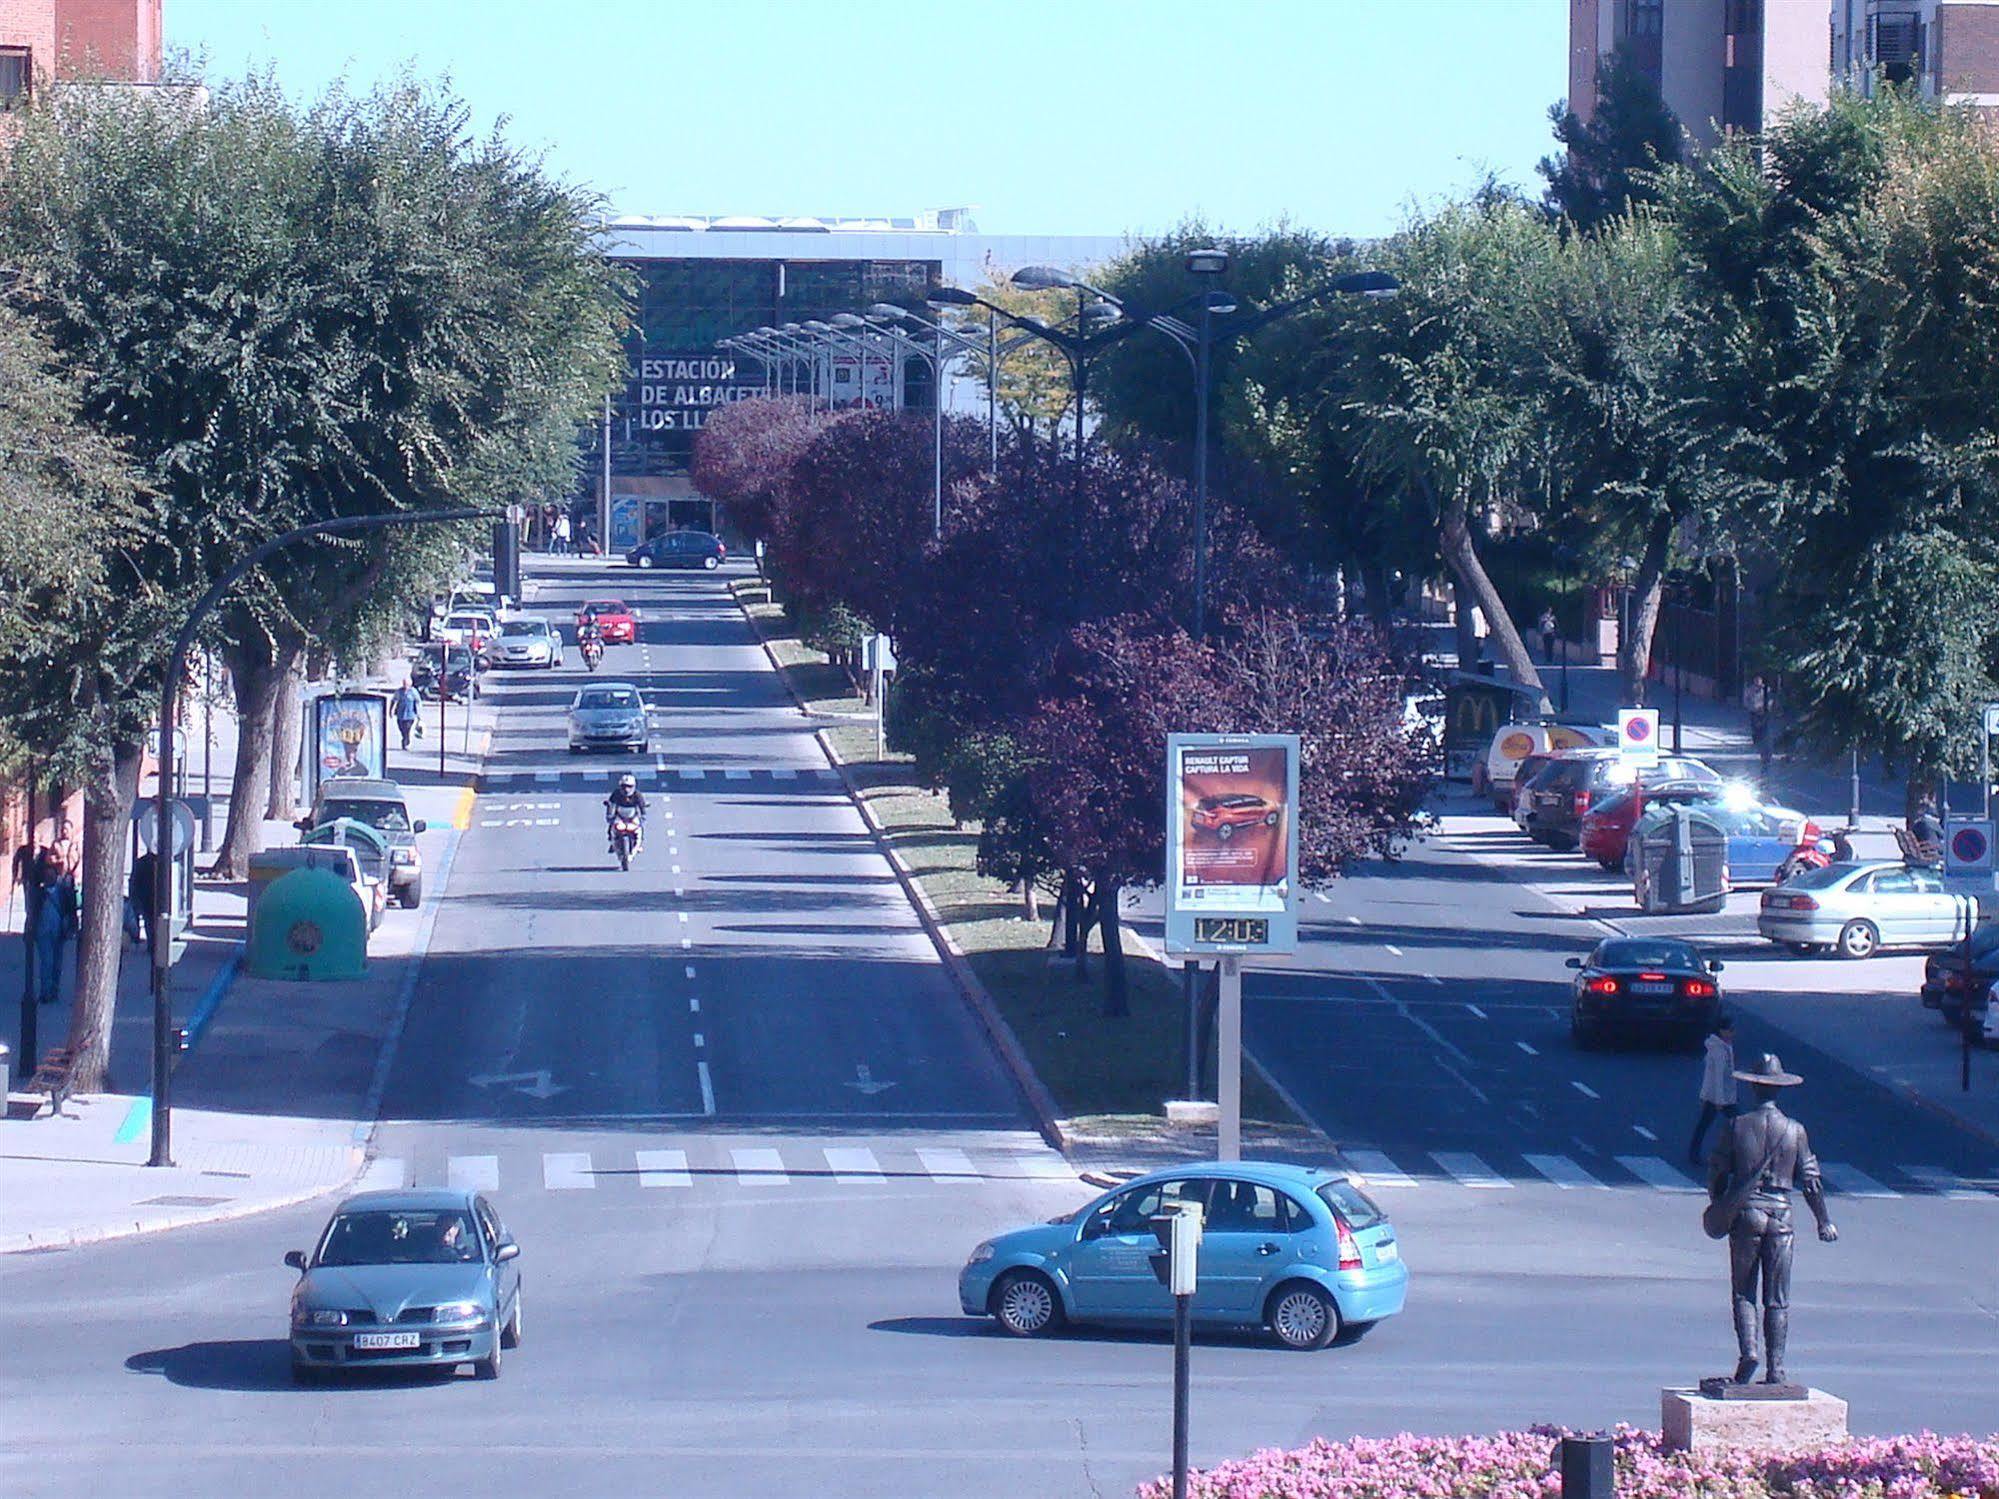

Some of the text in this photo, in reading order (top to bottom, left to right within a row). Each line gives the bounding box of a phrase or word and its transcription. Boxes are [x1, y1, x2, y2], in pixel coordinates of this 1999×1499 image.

[641, 355, 736, 380] ESTACIÓN
[641, 386, 668, 405] DE
[641, 410, 676, 430] LOS
[1220, 765, 1231, 773] LA
[362, 1334, 417, 1347] 8407 CRZ
